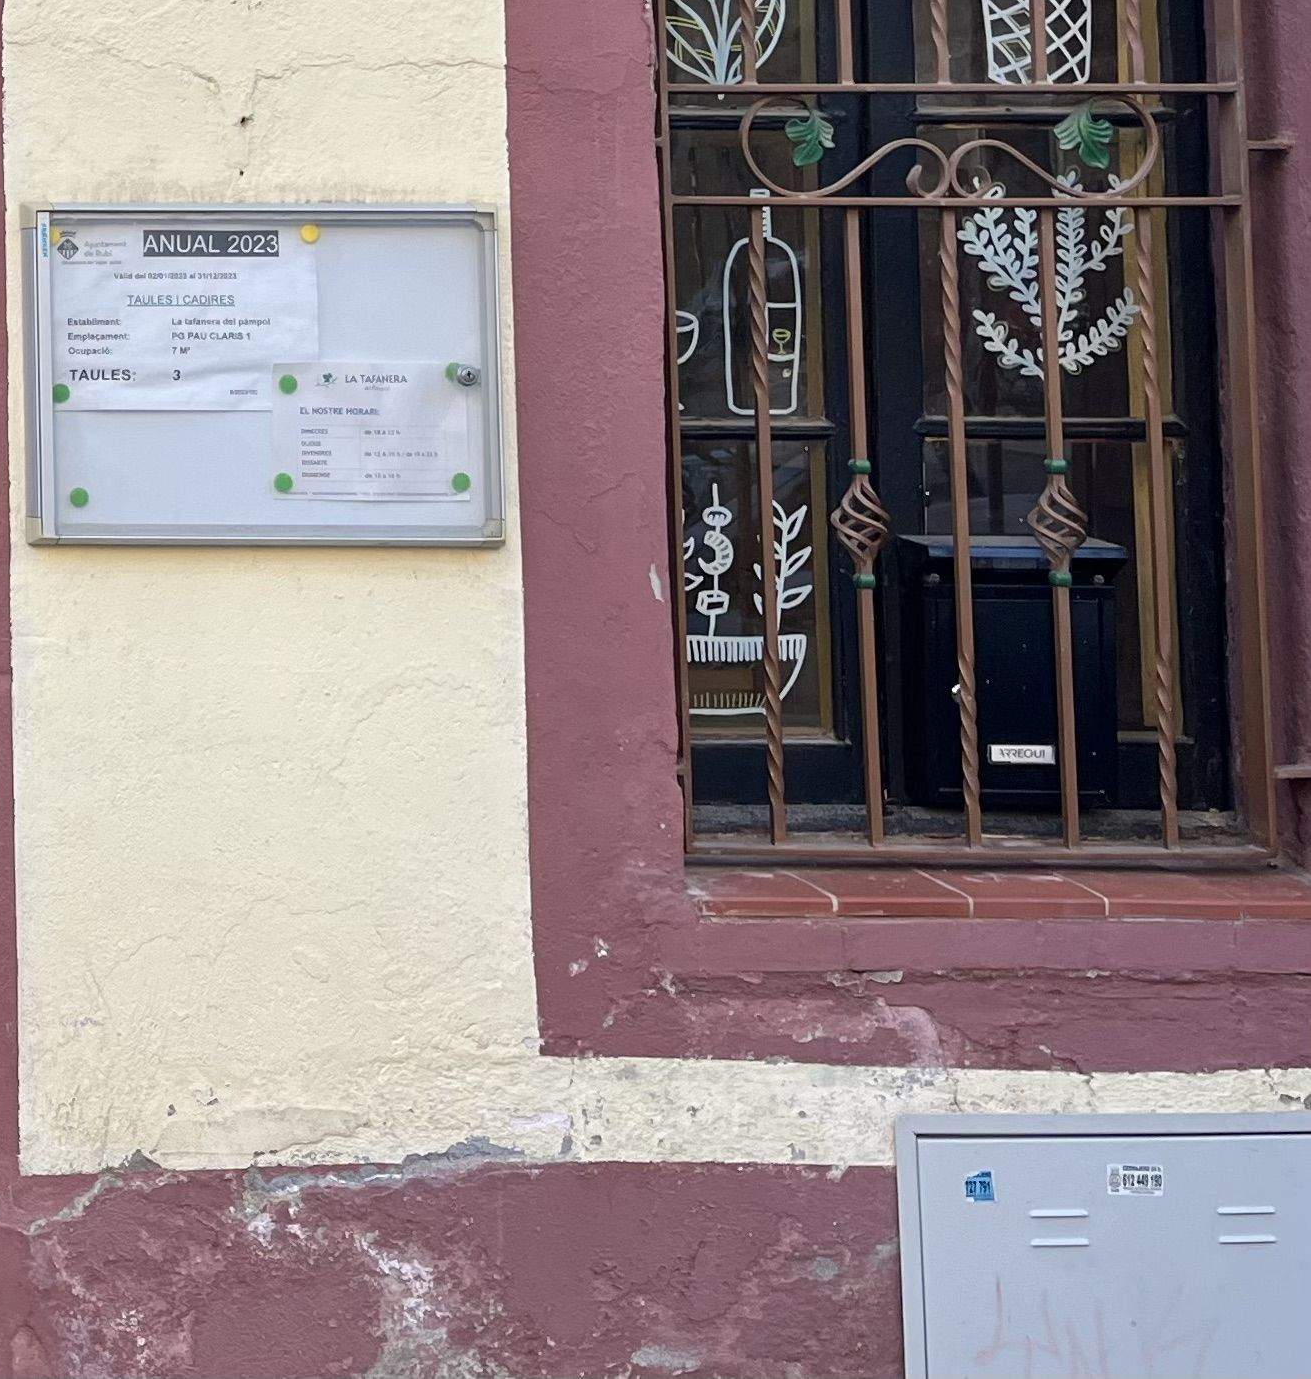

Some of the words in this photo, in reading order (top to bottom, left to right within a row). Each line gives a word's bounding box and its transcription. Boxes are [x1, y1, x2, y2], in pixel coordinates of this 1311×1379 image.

[144, 234, 221, 254] ANUAL
[227, 234, 279, 254] 2023
[127, 294, 173, 306] TAULES
[183, 294, 236, 306] CADIRES
[171, 317, 182, 326] La
[184, 317, 221, 326] tafanera
[223, 317, 236, 326] del
[171, 332, 185, 340] PG
[187, 332, 207, 340] PAU
[209, 332, 244, 340] CLARIS
[69, 369, 137, 382] TAULES:
[172, 369, 181, 381] 3
[345, 374, 358, 384] LA
[360, 374, 408, 384] TAFANERA
[299, 406, 309, 415] EL
[312, 407, 343, 415] NOSTRE
